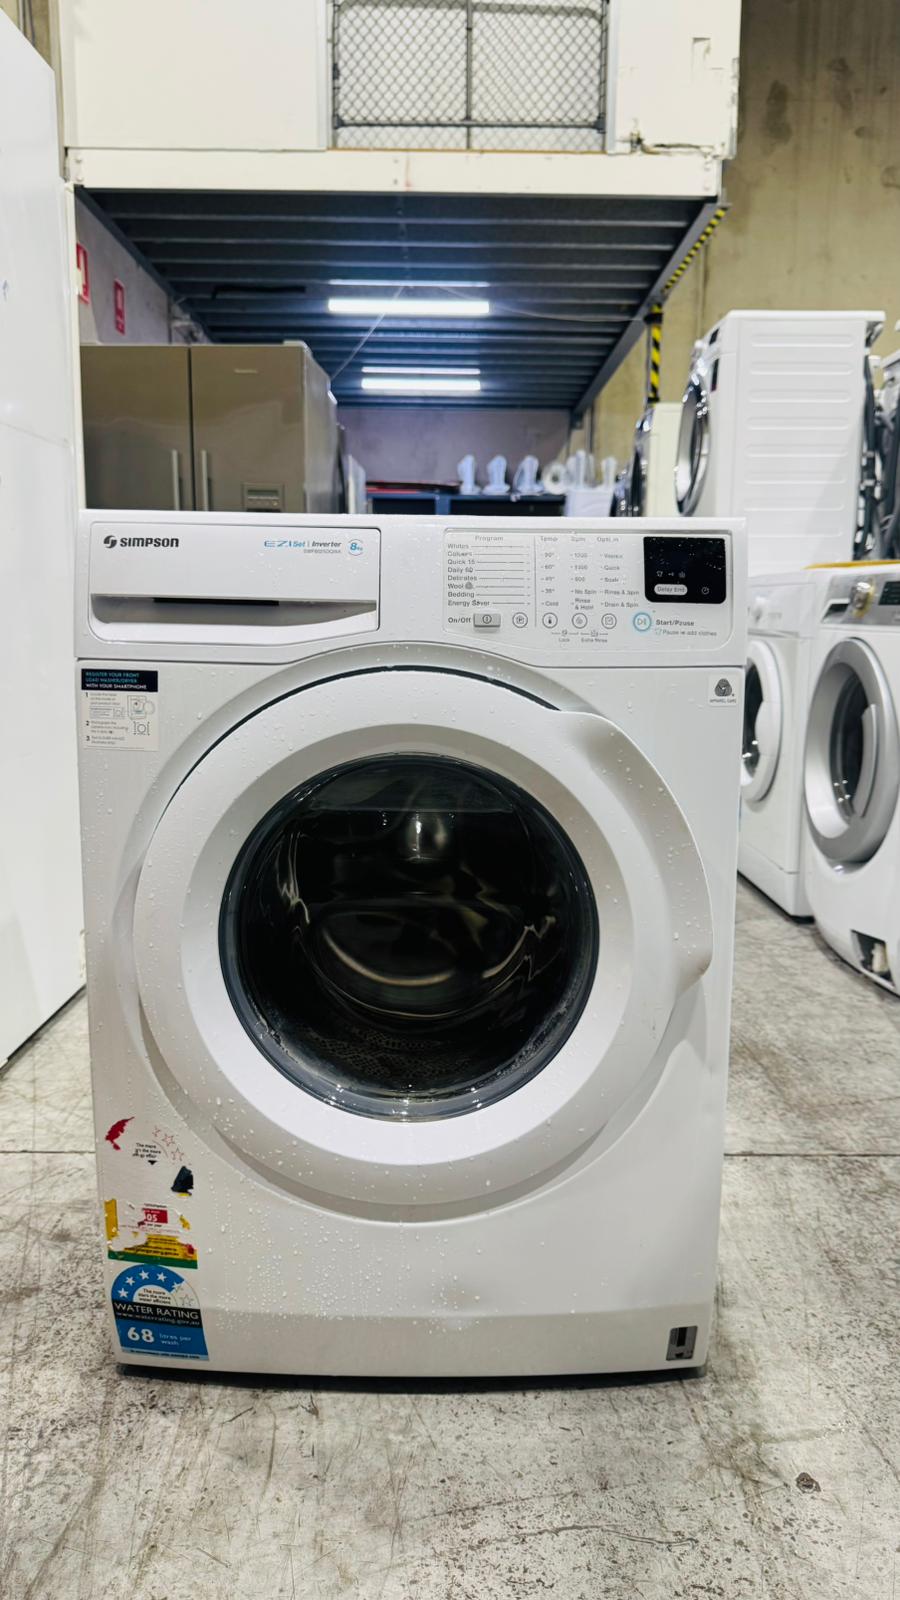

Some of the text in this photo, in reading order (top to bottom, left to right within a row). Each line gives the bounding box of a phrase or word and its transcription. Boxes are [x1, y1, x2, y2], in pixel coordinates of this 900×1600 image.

[119, 537, 179, 547] SIMPSON
[447, 566, 464, 574] Daily
[447, 591, 475, 599] Bedding
[447, 599, 490, 608] Energy Saver
[655, 619, 695, 627] Start/Pause
[113, 1302, 200, 1320] WATER RATING
[127, 1326, 155, 1343] 68
